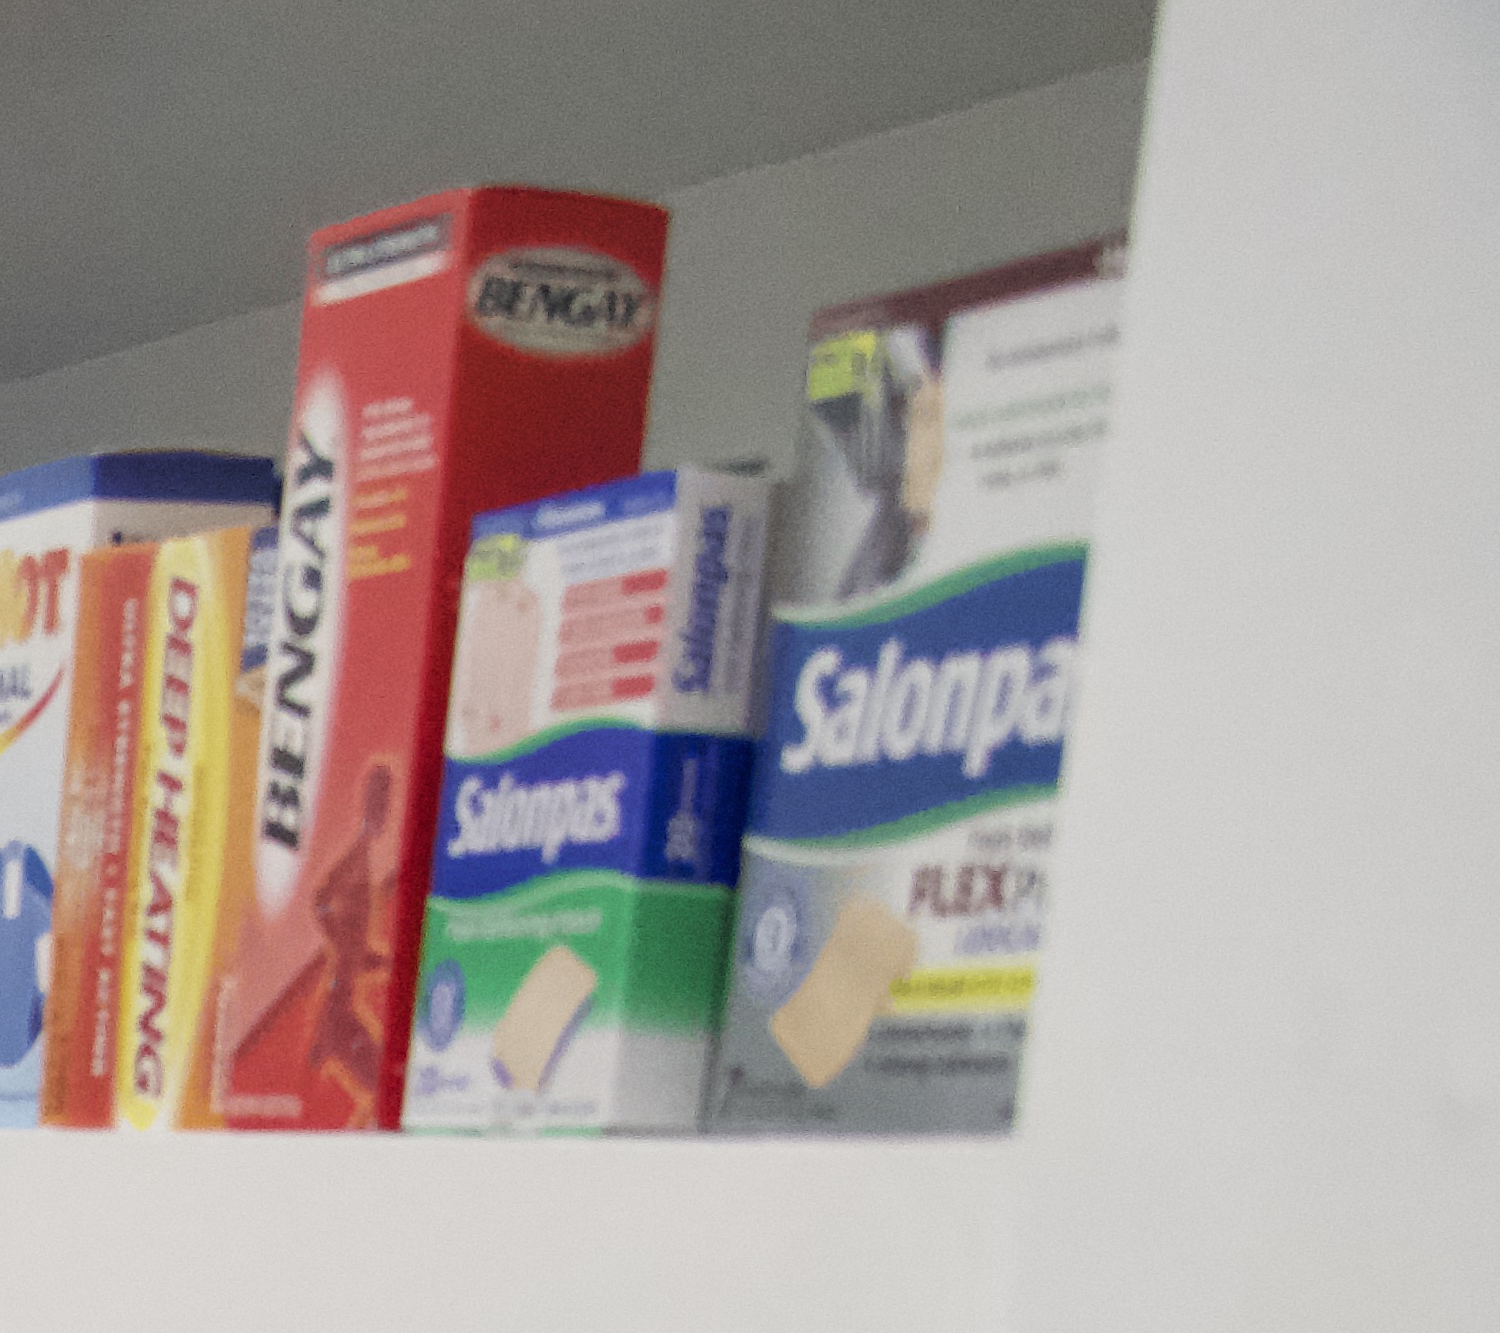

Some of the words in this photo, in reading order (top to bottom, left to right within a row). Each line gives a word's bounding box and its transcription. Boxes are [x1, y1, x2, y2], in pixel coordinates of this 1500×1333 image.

[155, 577, 200, 773] DEEP
[262, 428, 335, 851] BENGAY
[780, 637, 1078, 778] Salonpa
[447, 771, 626, 864] Salonpas
[134, 771, 183, 1100] HEATING
